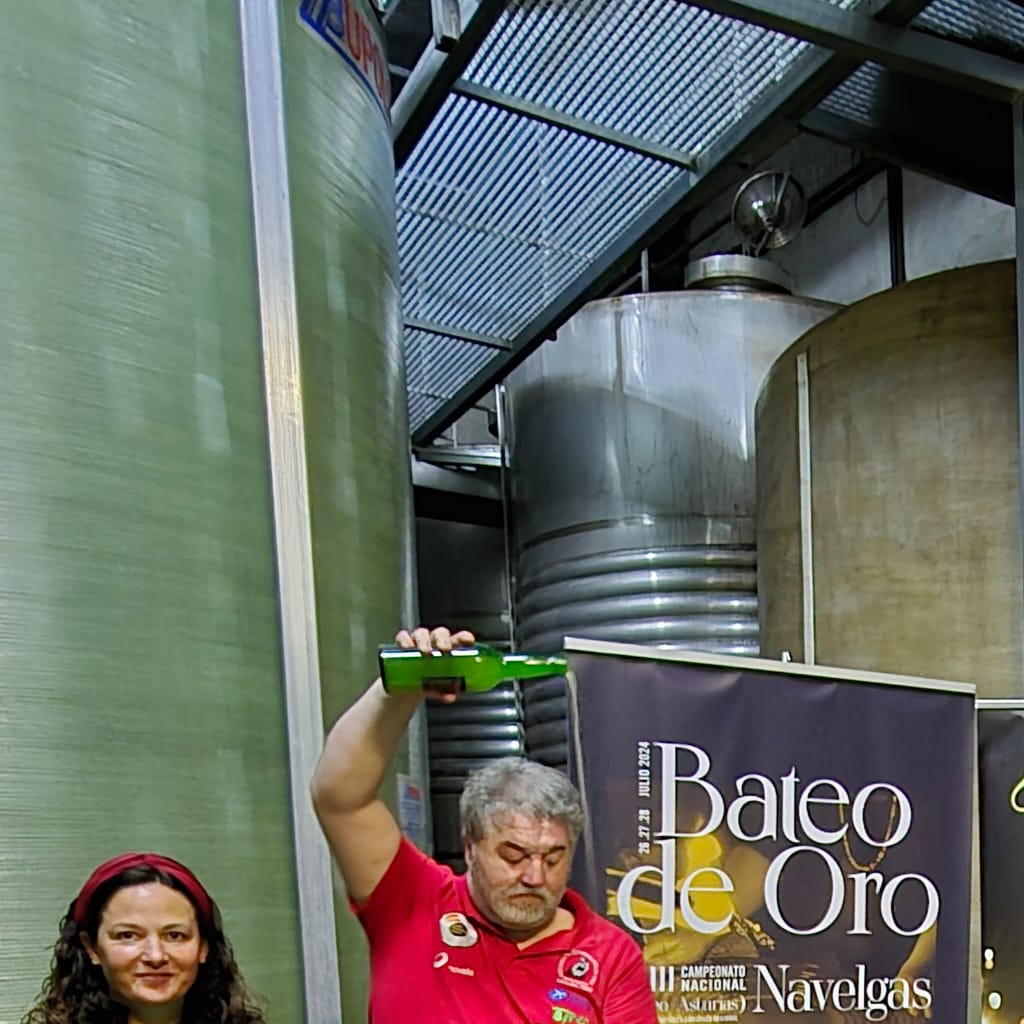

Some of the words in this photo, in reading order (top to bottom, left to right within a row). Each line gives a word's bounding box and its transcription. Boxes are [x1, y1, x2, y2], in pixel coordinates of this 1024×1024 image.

[639, 741, 650, 767] 2024
[639, 769, 650, 797] JULIO
[654, 740, 912, 847] Bateo
[616, 839, 735, 935] de
[763, 845, 940, 937] Oro
[681, 964, 746, 979] CAMPEONATO
[681, 978, 748, 992] NACIONAL
[752, 963, 933, 1022] Navelgas
